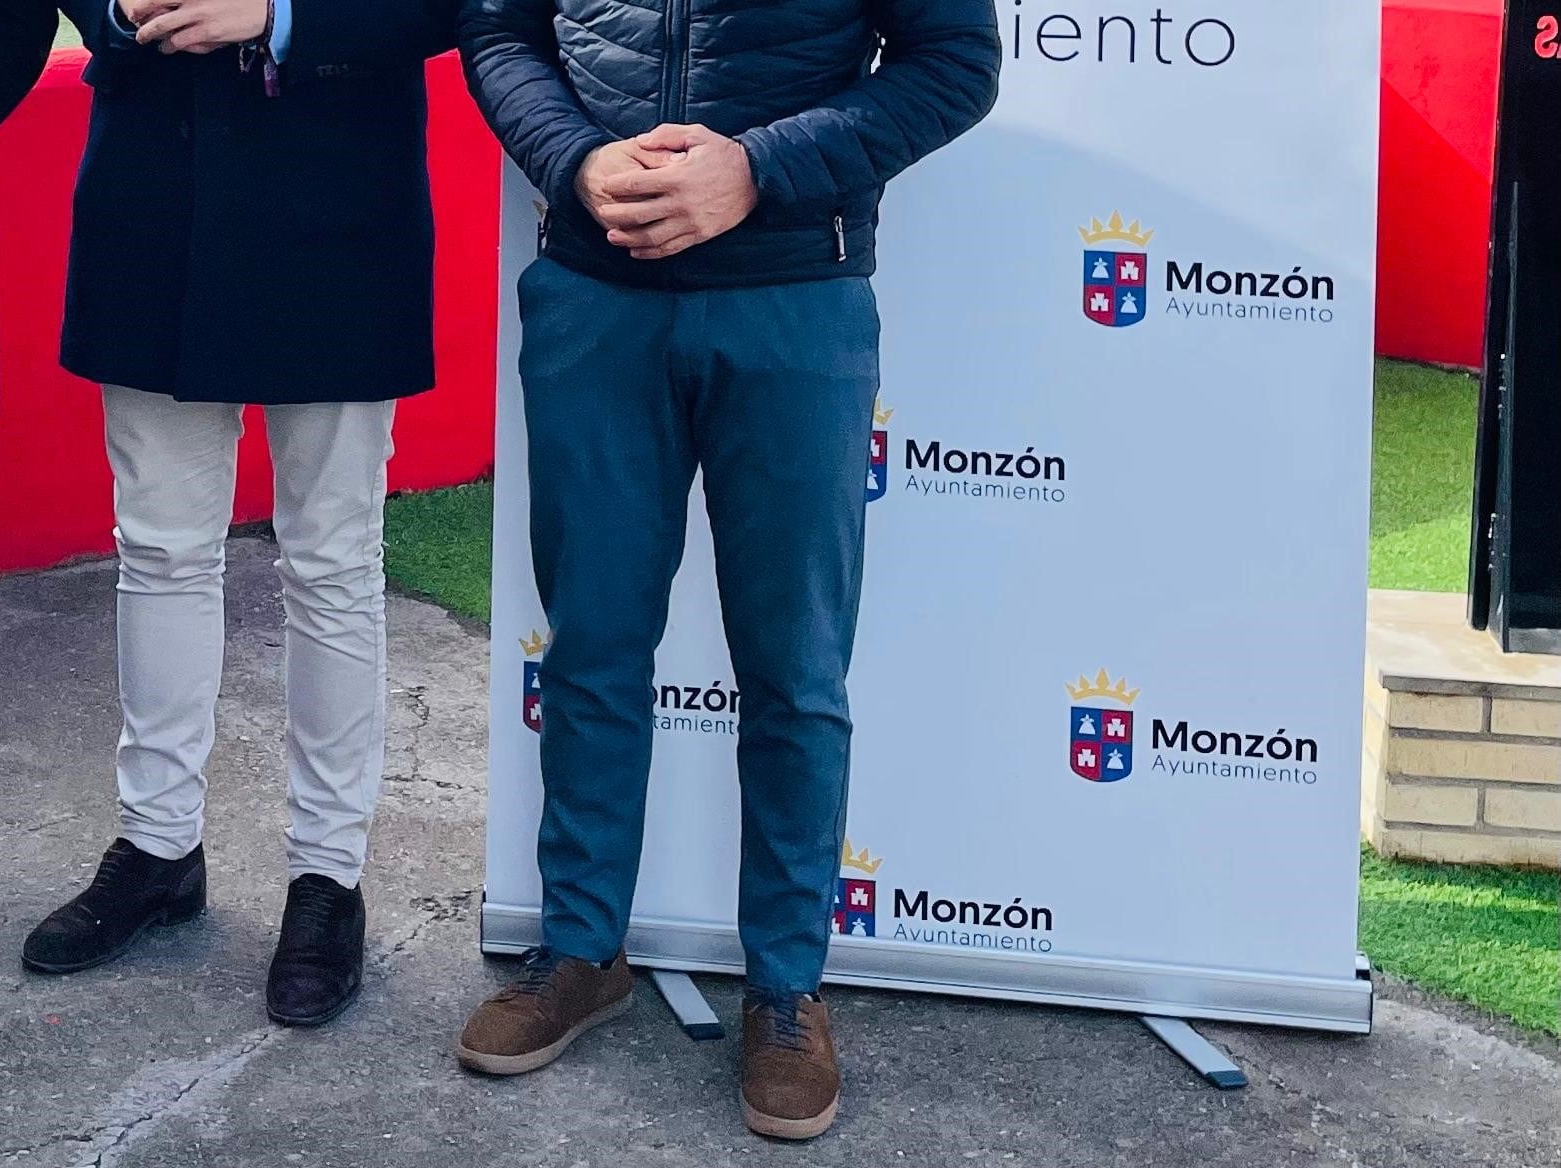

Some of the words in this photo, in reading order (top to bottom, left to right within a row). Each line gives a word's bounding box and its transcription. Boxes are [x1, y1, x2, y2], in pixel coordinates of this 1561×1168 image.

[1165, 260, 1335, 301] Monzón
[1165, 296, 1334, 323] Ayuntamiento
[904, 438, 1066, 481] Monzón
[905, 474, 1066, 503] Ayuntamiento
[653, 715, 740, 735] tamient
[1151, 718, 1318, 763] Monzón
[1151, 754, 1318, 785] Ayuntamiento
[893, 888, 1053, 931] Monzón
[894, 923, 1053, 953] Ayuntamiento
